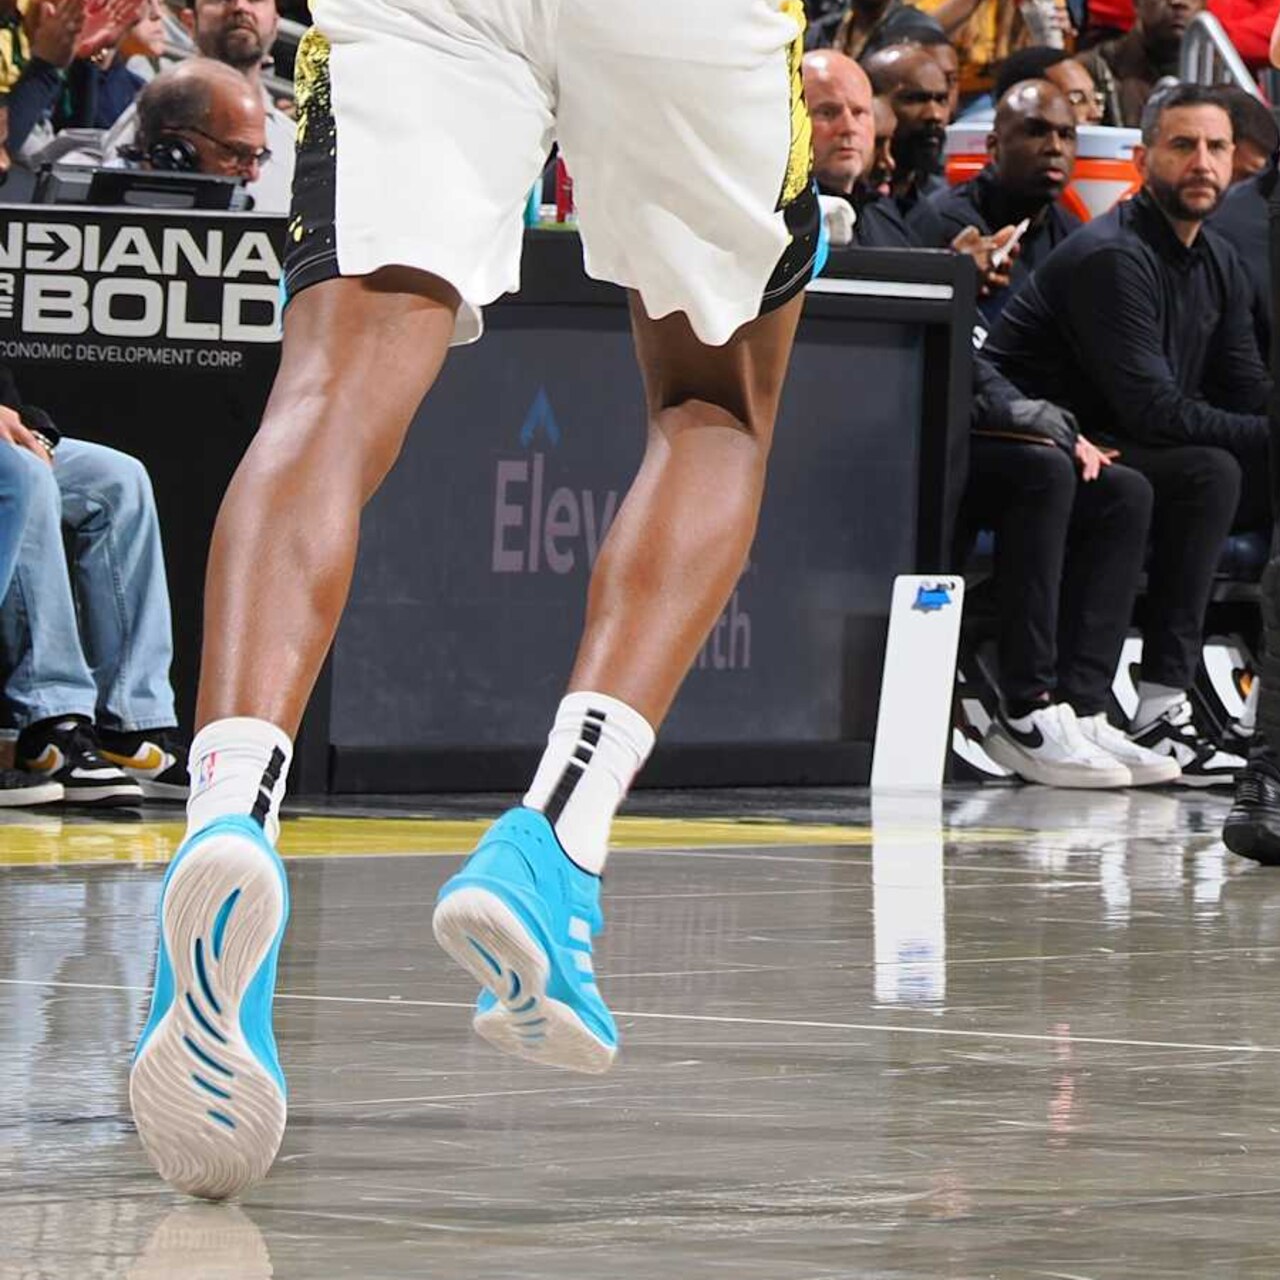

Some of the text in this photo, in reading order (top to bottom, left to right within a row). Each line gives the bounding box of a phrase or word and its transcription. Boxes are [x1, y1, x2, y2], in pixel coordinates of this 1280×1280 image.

[21, 273, 284, 343] BOLD
[76, 344, 195, 366] DEVELOPMENT
[197, 349, 243, 369] CORP.
